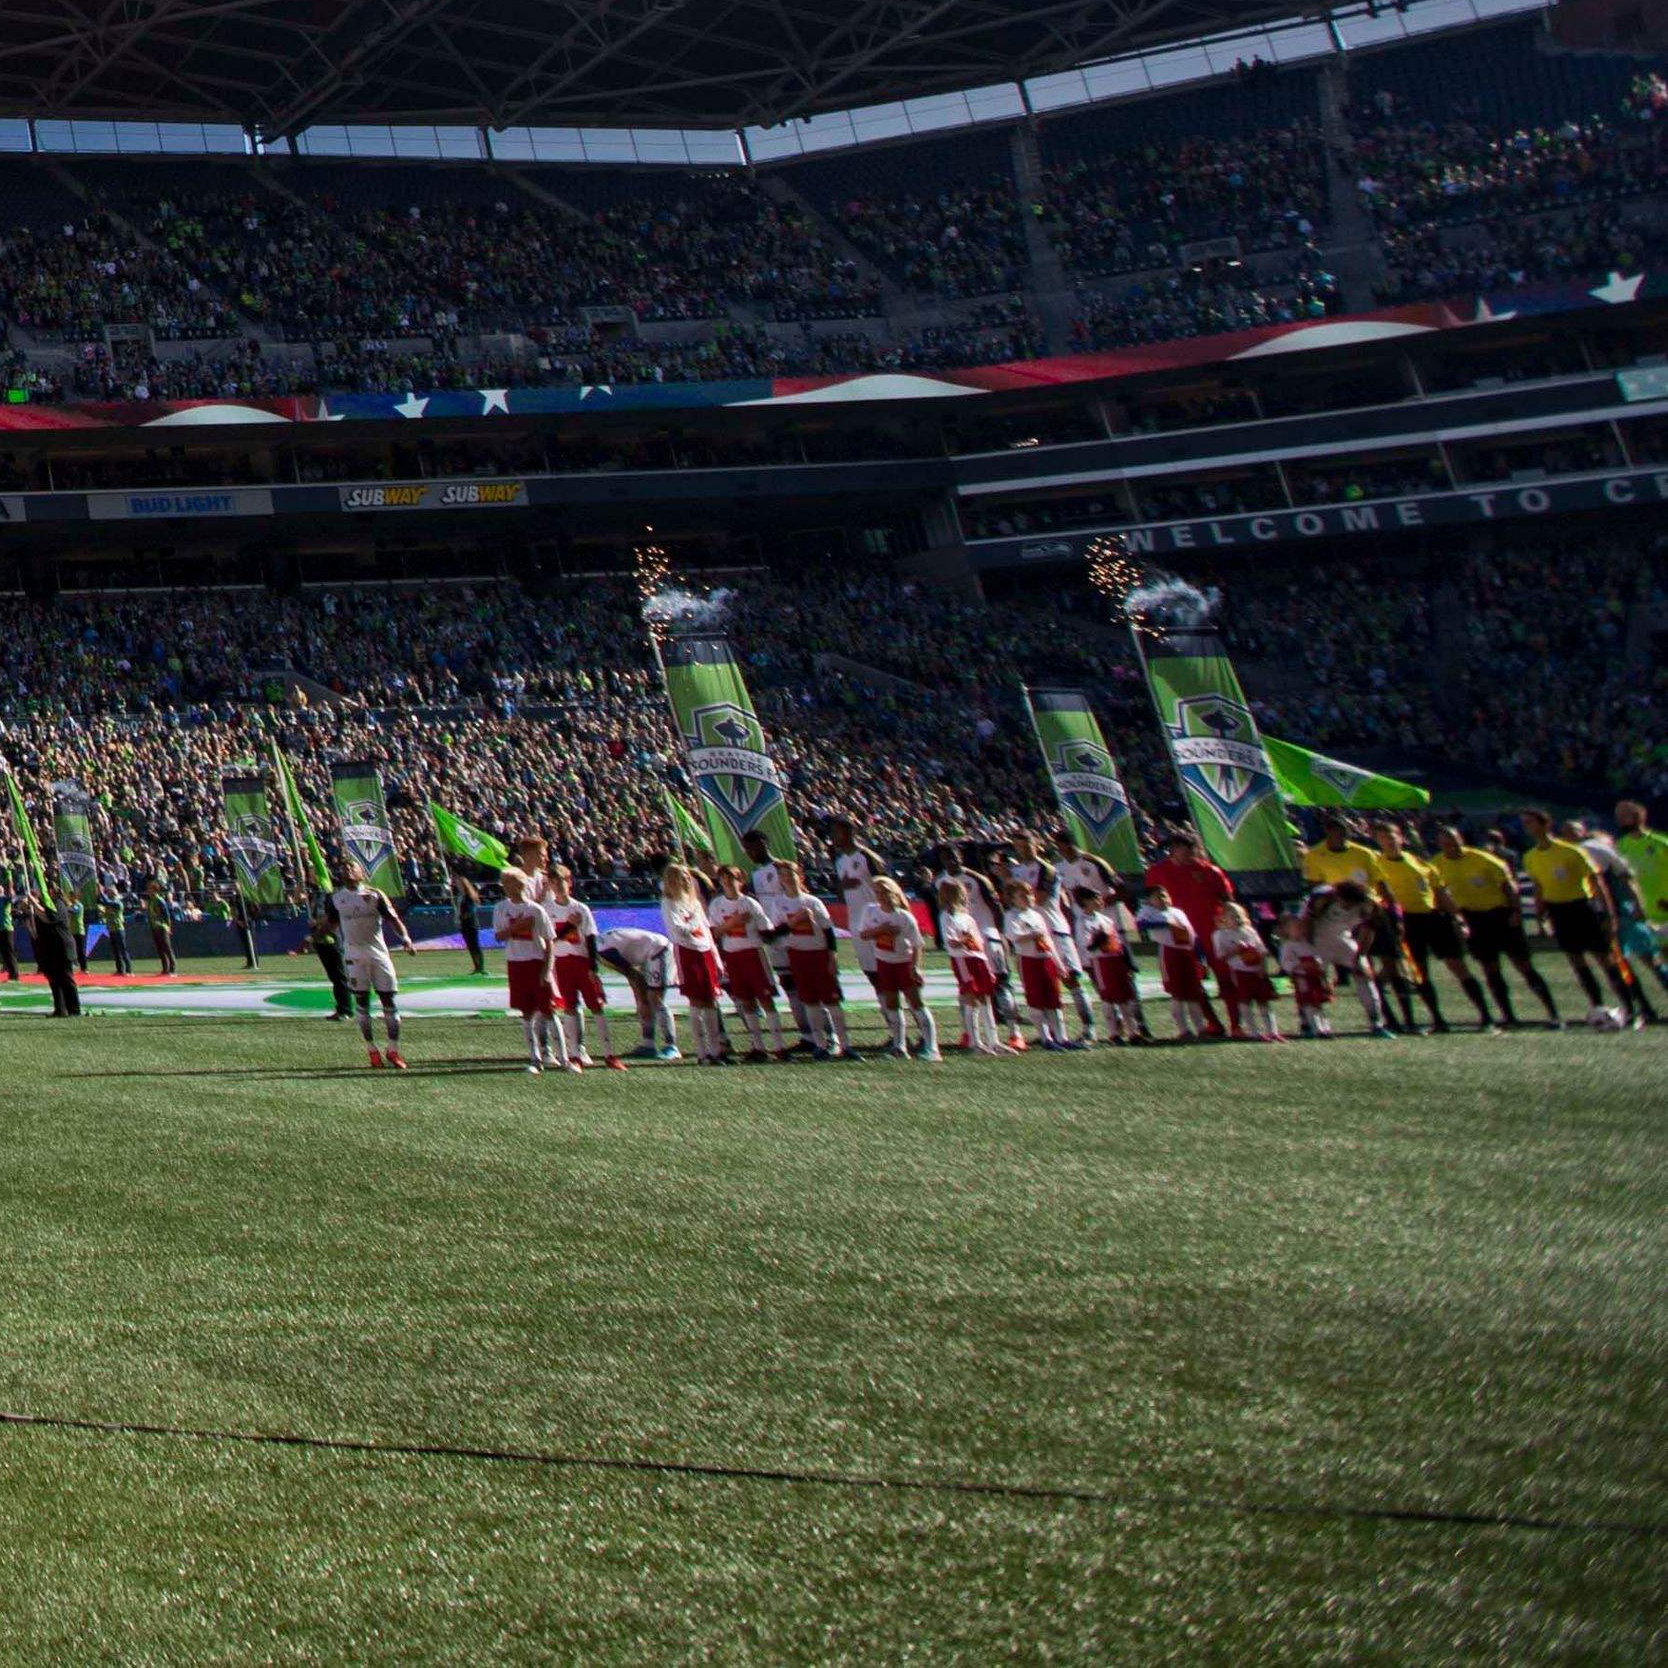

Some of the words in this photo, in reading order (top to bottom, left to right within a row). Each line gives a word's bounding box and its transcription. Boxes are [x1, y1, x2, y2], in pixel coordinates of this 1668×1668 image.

[131, 495, 170, 514] BUD
[173, 494, 232, 513] LIGHT
[347, 486, 427, 508] SUBWAY
[440, 483, 521, 505] SUBWAY
[1125, 500, 1424, 554] WELCOME
[1469, 487, 1552, 519] TO
